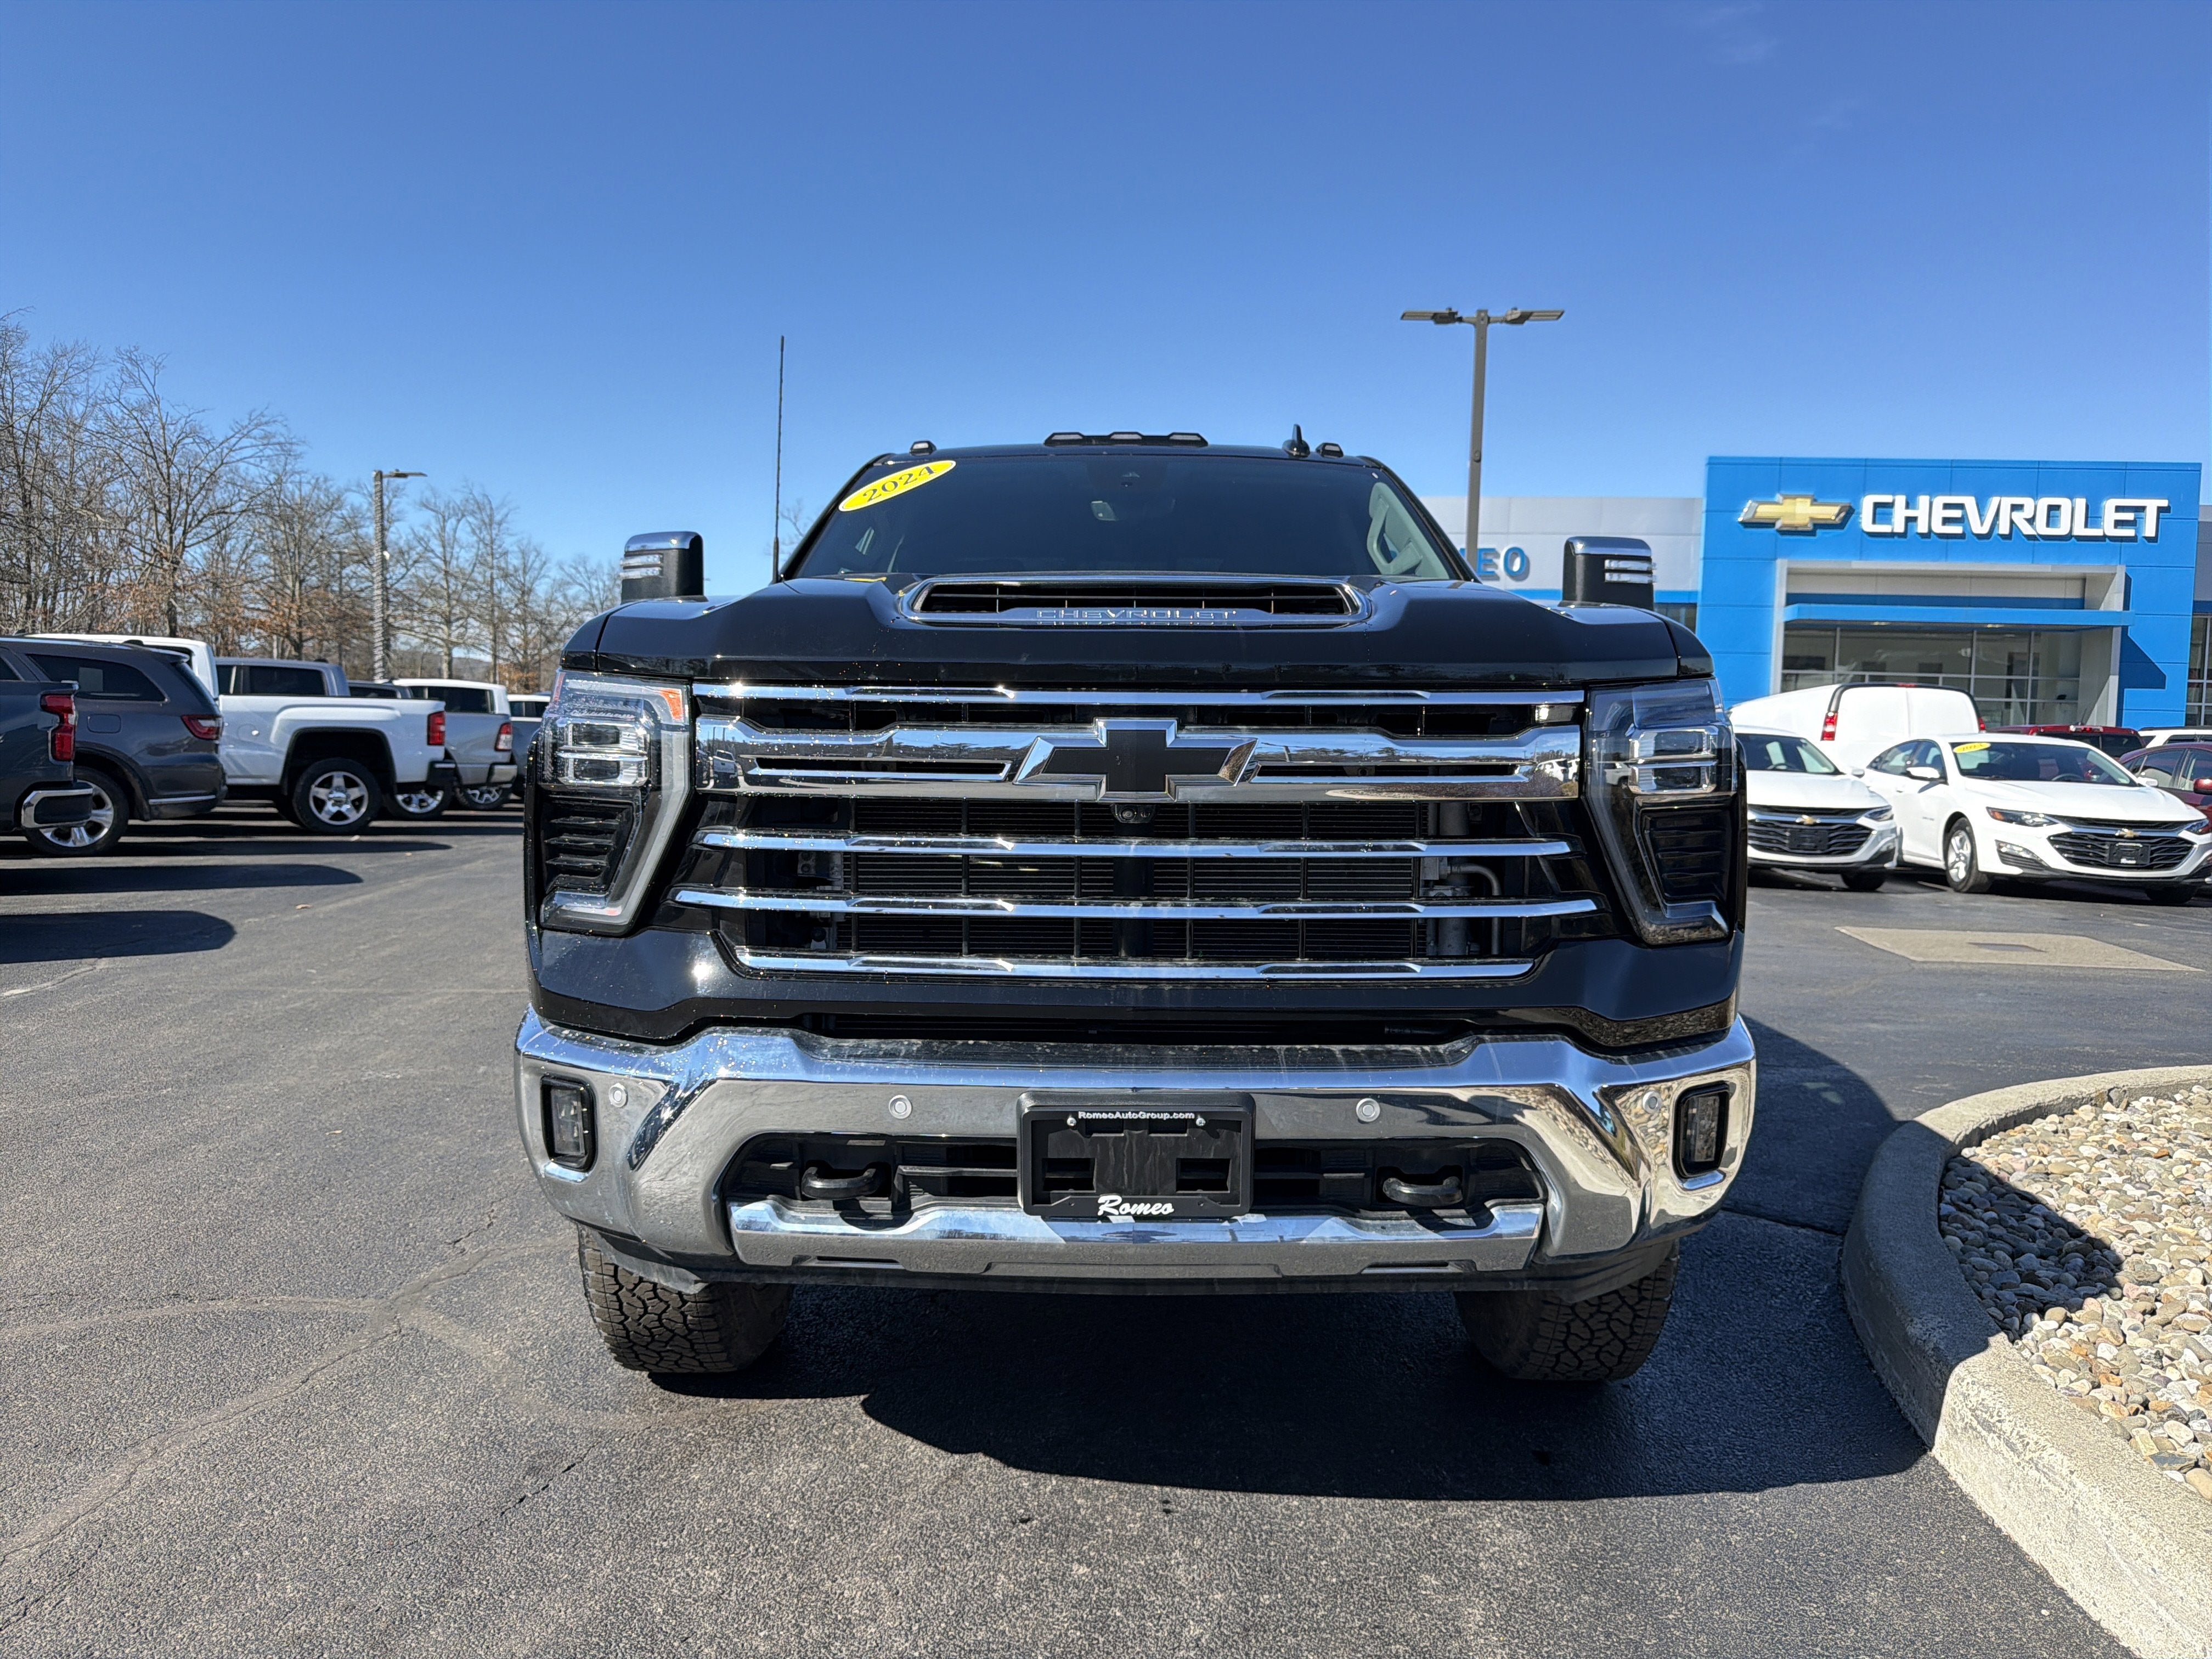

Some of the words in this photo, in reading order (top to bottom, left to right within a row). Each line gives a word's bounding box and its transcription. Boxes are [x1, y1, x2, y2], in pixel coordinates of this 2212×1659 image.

[863, 466, 936, 502] 2024
[1860, 494, 2169, 537] CHEVROLET
[1459, 546, 1527, 576] EO
[1036, 609, 1236, 619] CHEVROLET
[1078, 1111, 1195, 1120] RomeoAutoGroup.com
[1097, 1195, 1175, 1216] Romeo
